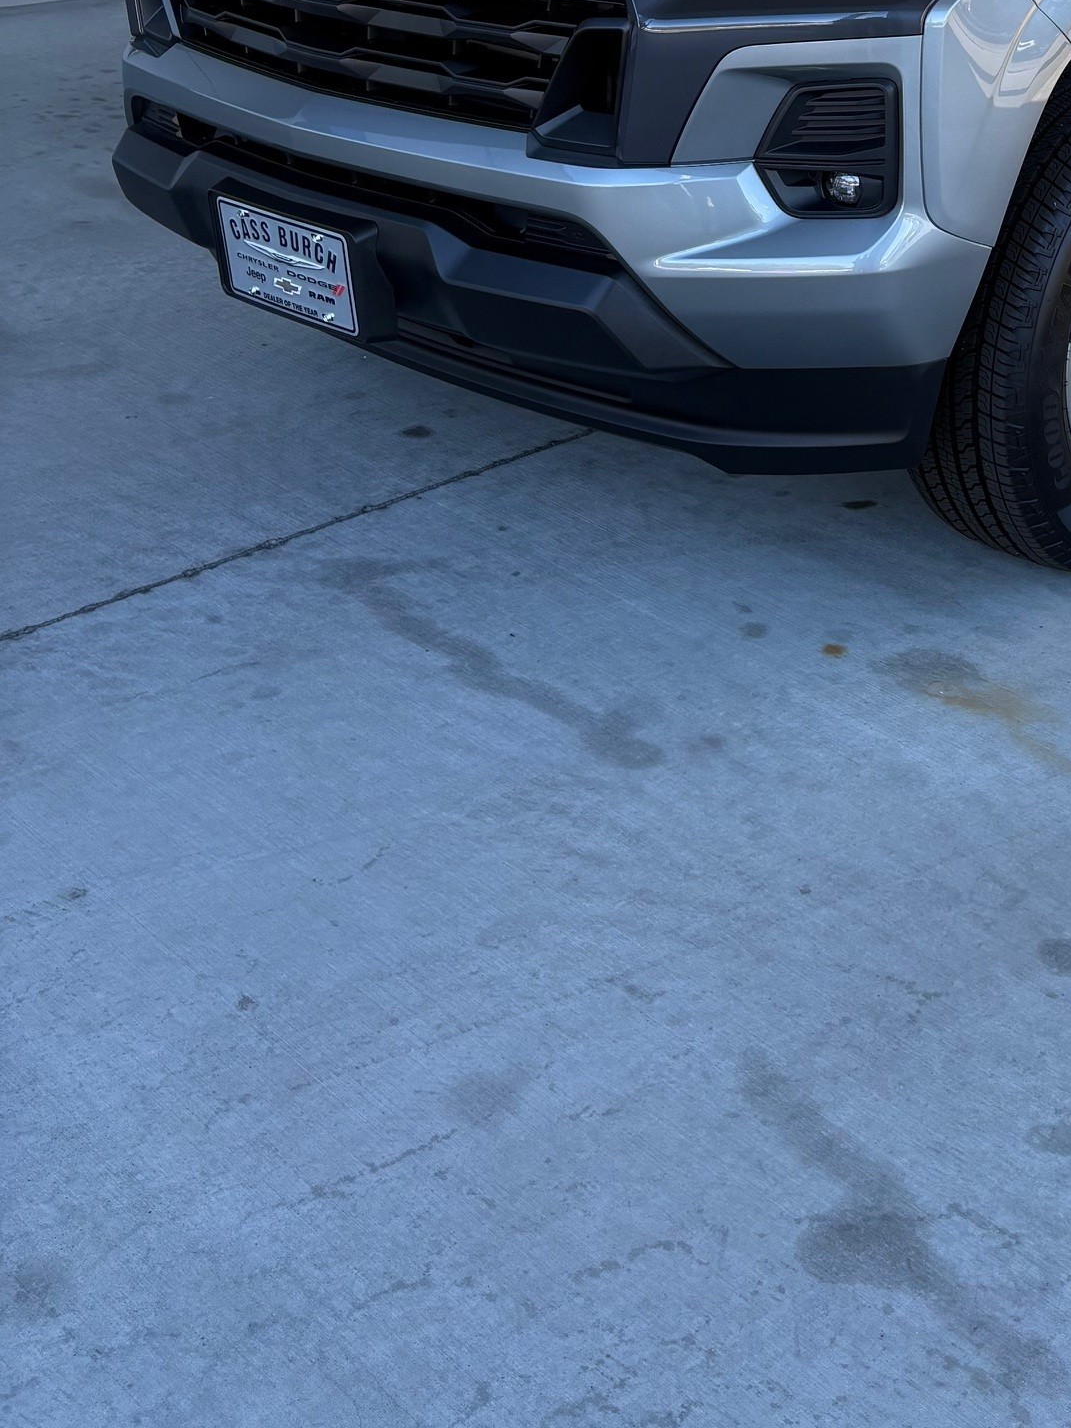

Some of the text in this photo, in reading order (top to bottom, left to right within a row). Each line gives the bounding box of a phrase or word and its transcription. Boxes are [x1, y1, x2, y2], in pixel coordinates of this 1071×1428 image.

[229, 219, 337, 274] CASS BURCH
[237, 252, 336, 291] CHRYSLER DODGE
[246, 266, 266, 283] Jeep
[263, 292, 318, 317] DEALER OF THE YEAR
[308, 290, 336, 306] RAM
